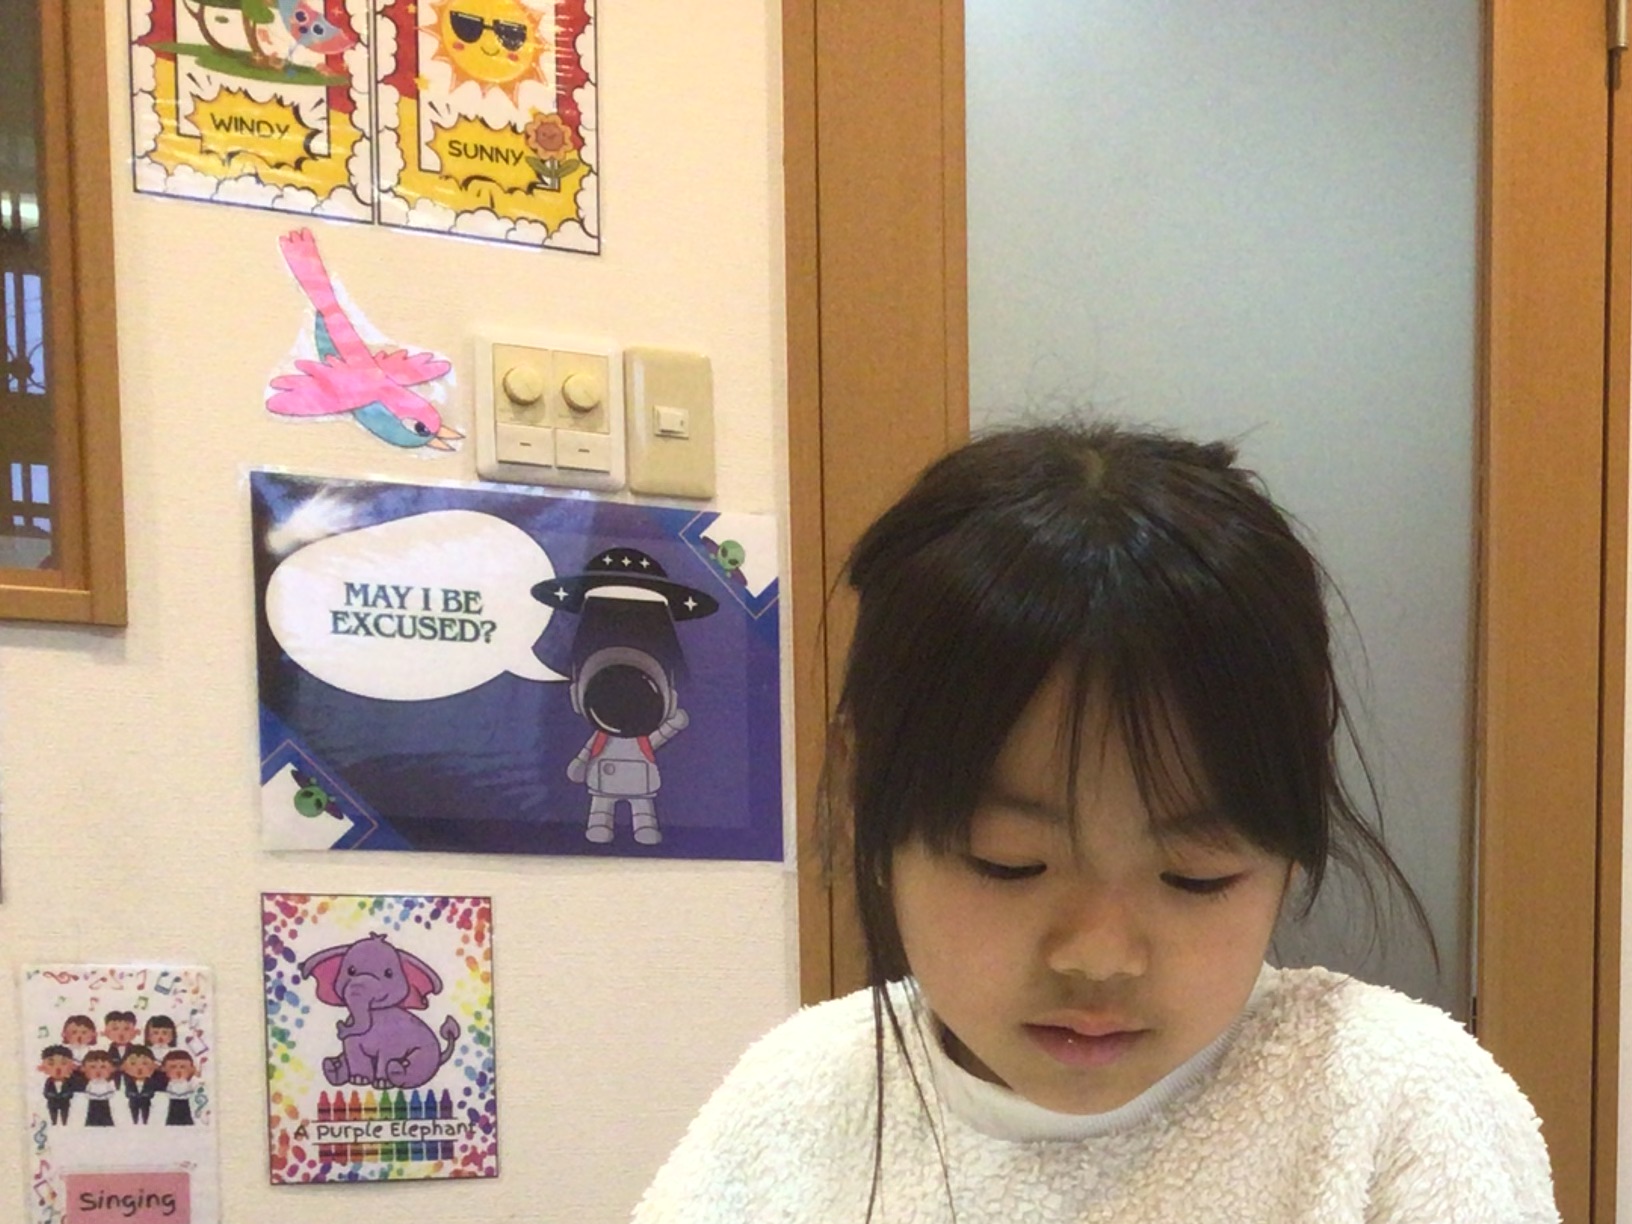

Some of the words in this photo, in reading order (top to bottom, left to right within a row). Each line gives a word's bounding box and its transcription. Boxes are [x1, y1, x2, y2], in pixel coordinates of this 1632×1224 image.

[210, 113, 290, 140] WINDY
[447, 139, 524, 166] SUNNY
[343, 581, 414, 610] MAY
[420, 587, 432, 611] I
[441, 588, 484, 615] BE
[329, 609, 497, 644] EXCUSED?
[294, 1124, 309, 1139] A
[390, 1119, 476, 1141] Elephant
[79, 1189, 176, 1217] Singing
